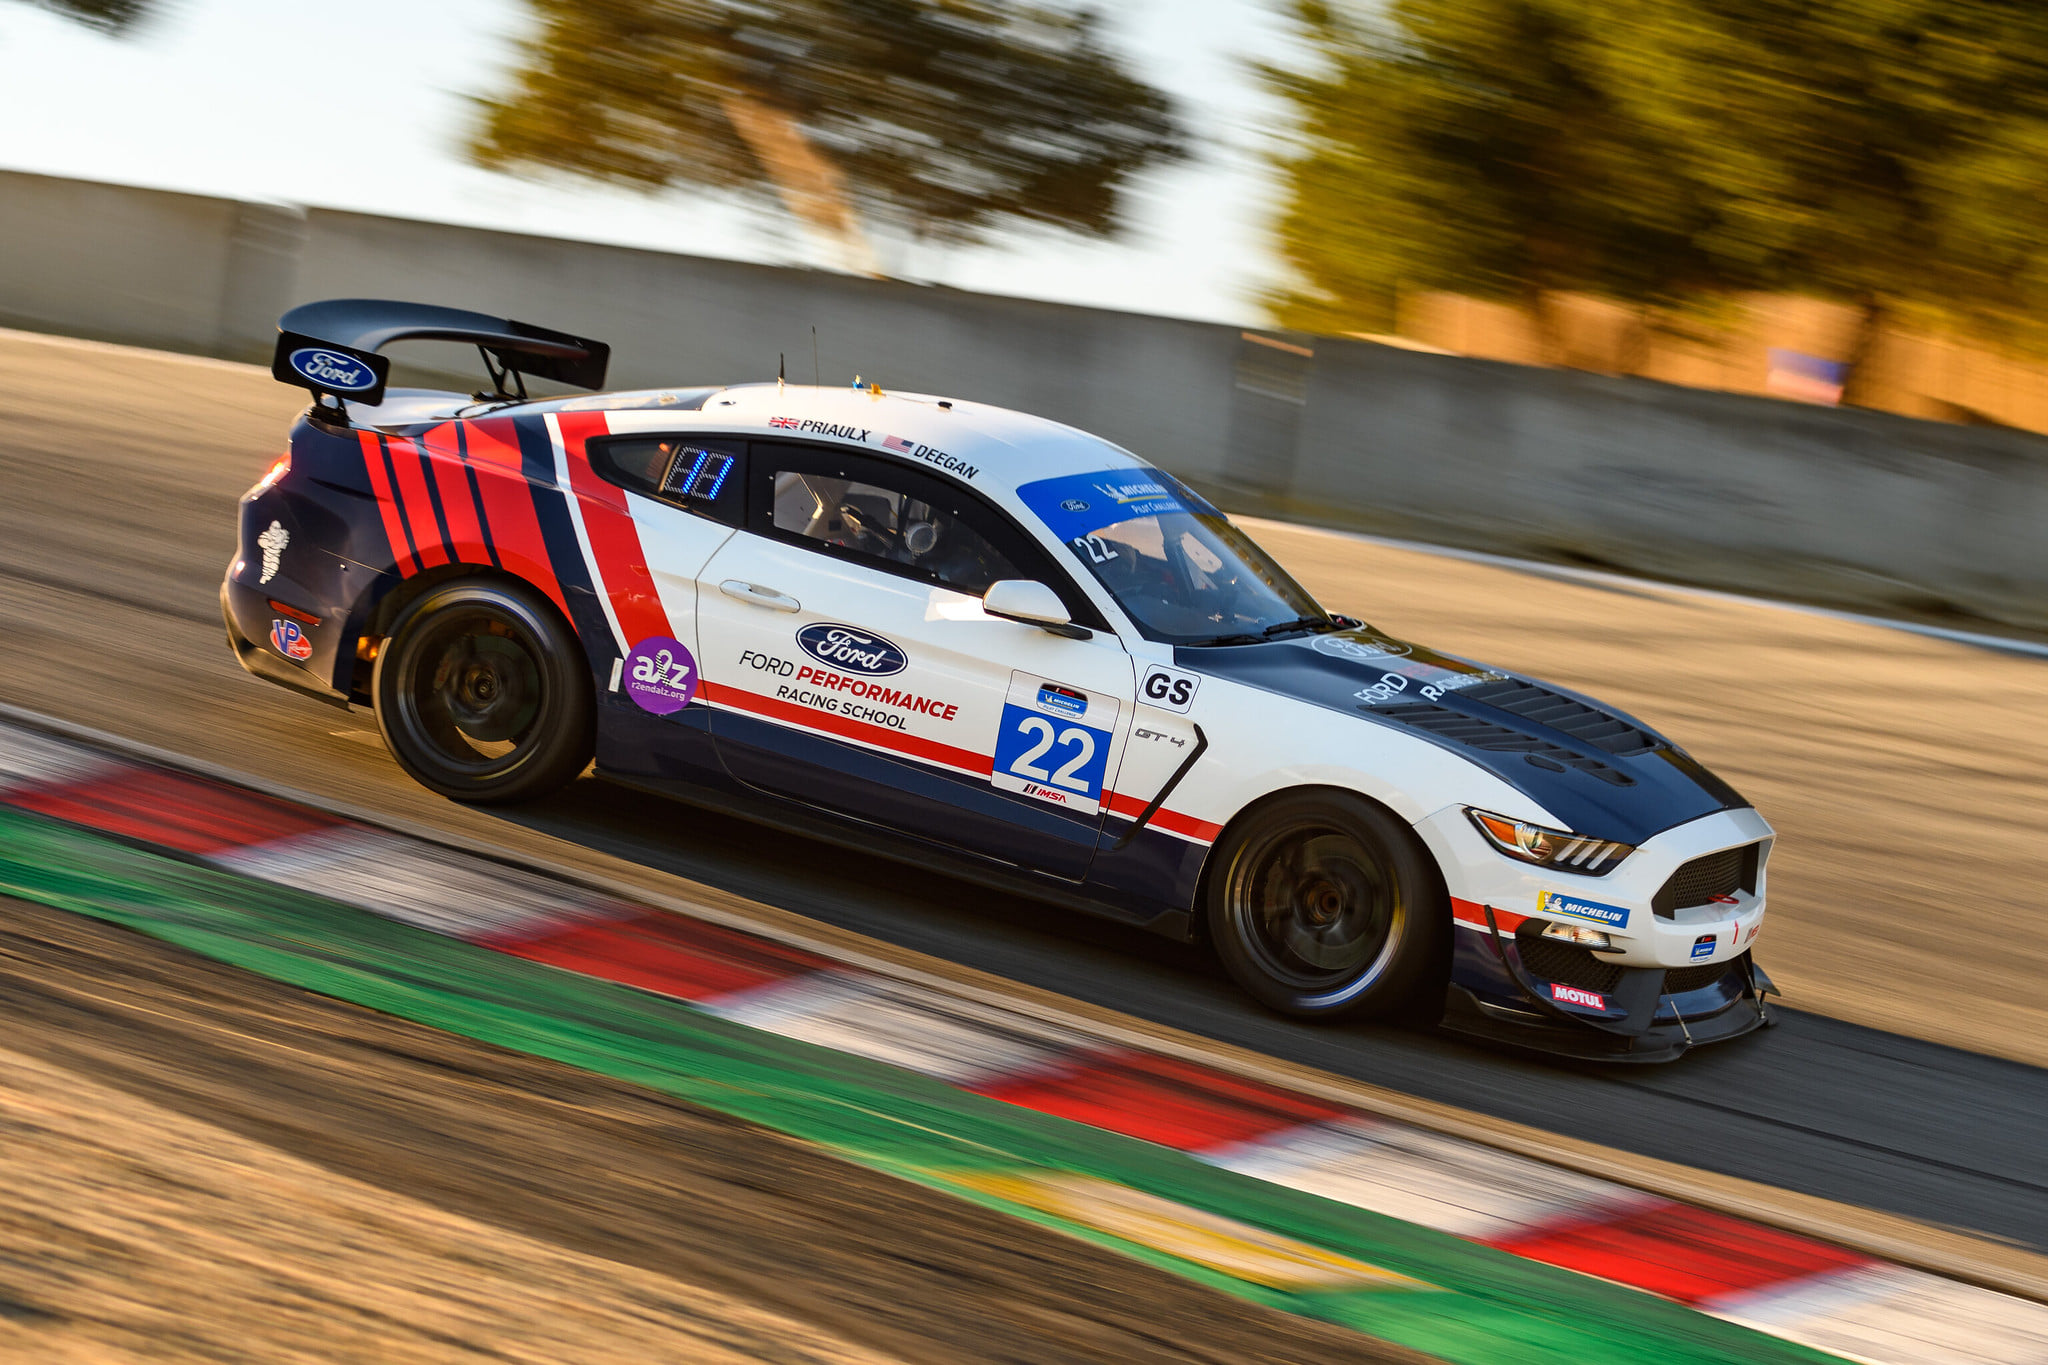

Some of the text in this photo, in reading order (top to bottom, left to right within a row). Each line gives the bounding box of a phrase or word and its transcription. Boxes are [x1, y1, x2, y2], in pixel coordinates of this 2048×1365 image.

[305, 353, 361, 385] Ford
[800, 419, 872, 442] PRIAULX
[913, 445, 979, 479] DEEGAN
[1074, 534, 1119, 564] 22
[273, 619, 301, 654] VP
[816, 629, 887, 670] Ford
[738, 650, 959, 721] FORD PERFORMANCE
[1145, 673, 1193, 705] GS
[1353, 672, 1408, 704] FORD
[776, 685, 907, 730] RACING SCHOOL
[1009, 717, 1095, 793] 22
[1037, 788, 1067, 803] IMSA
[1564, 903, 1623, 922] MICHELIN
[1555, 986, 1603, 1008] MOTUL
